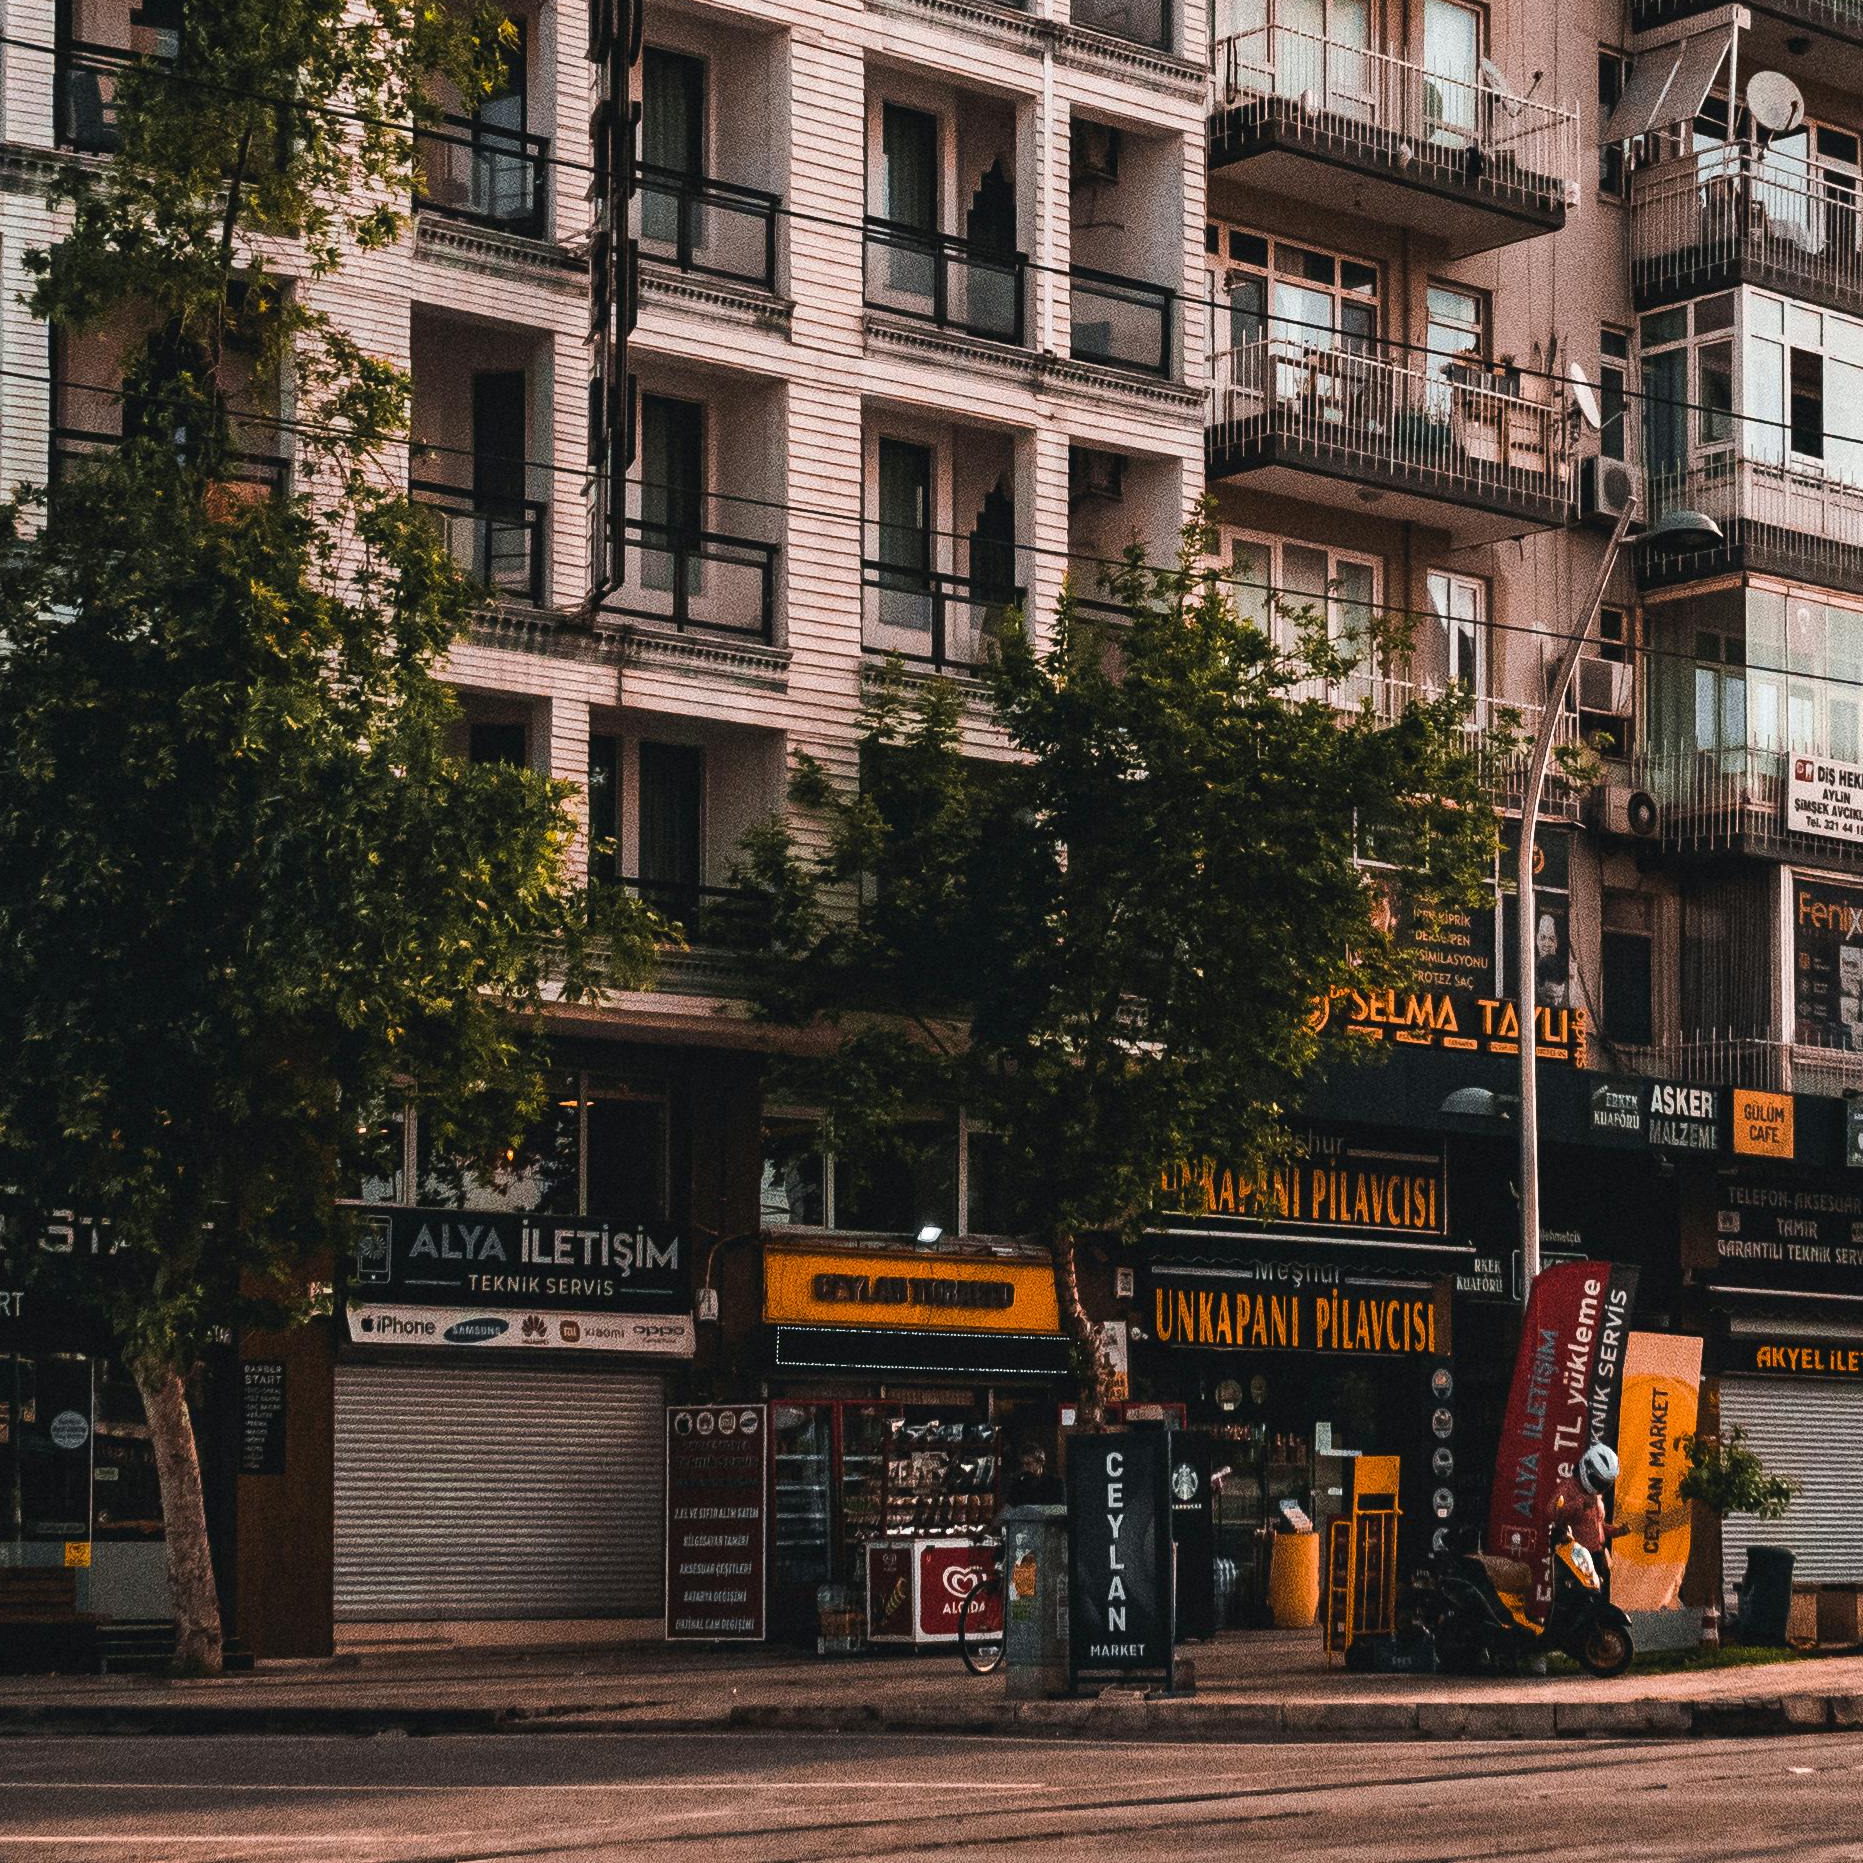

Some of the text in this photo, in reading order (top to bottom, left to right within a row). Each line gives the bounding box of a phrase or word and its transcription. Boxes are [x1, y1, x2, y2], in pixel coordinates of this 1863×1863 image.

[1818, 765, 1835, 786] DİŞ
[1345, 987, 1460, 1033] SELMA
[1743, 1100, 1785, 1123] GÜLÜM
[1749, 1124, 1781, 1144] CAFE
[1312, 1157, 1436, 1228] PİLAVCISI
[408, 1218, 680, 1278] ALYA İLETİŞİM
[467, 1273, 615, 1298] TEKNİK SERVİS
[1254, 1260, 1342, 1289] Meşhur
[377, 1315, 436, 1335] iPhone
[1154, 1286, 1436, 1353] UNKAPANI PİLAVCISI
[1560, 1277, 1602, 1408] yükleme
[1756, 1344, 1825, 1372] AKYEL
[1589, 1288, 1628, 1447] KNİK SERVİS
[1512, 1327, 1560, 1519] ALYA İLETİŞİM
[1553, 1415, 1583, 1458] TL
[1643, 1386, 1670, 1554] CEYLAN MARKET
[1104, 1450, 1128, 1633] CEYLAN
[1089, 1643, 1146, 1657] MARKET
